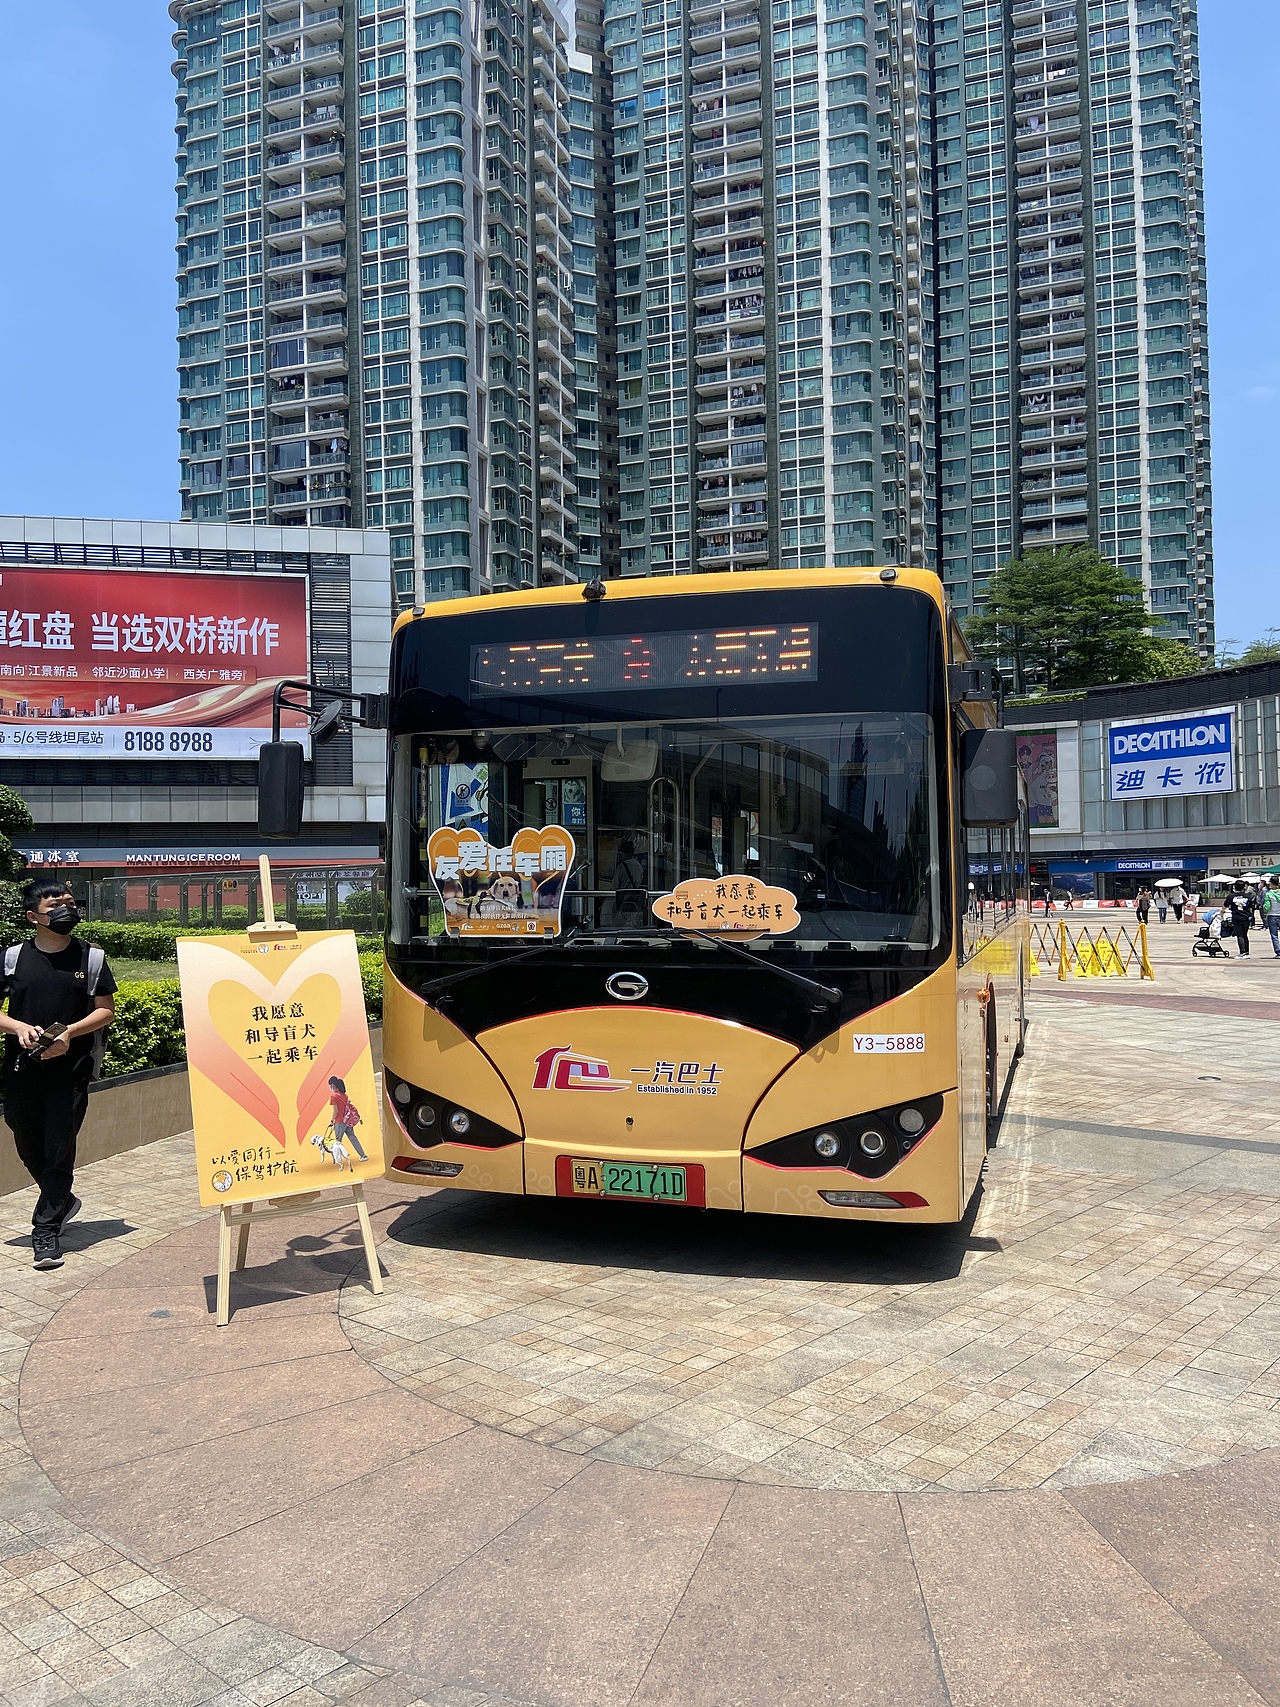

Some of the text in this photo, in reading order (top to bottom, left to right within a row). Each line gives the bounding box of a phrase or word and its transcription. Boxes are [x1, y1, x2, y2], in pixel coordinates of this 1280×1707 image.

[0, 609, 280, 656] 红盘 当选双桥新作
[91, 666, 165, 680] 邻近沙面小学
[183, 668, 243, 681] 西关广雅旁
[124, 731, 164, 751] 8188
[169, 732, 213, 752] 8988
[1113, 723, 1226, 755] DECATHLON
[1115, 761, 1226, 792] 迪卡侬
[18, 850, 80, 863] 通冰室
[126, 854, 152, 862] MAN
[153, 854, 186, 862] TUNG
[207, 853, 241, 861] ROOM
[434, 841, 567, 880] 友爱在车厢
[715, 883, 757, 900] 我愿意
[667, 901, 783, 920] 和导盲犬一起乘车
[252, 1003, 304, 1021] 我愿意
[245, 1023, 316, 1044] 和导盲犬
[854, 1036, 924, 1050] Y3-5888
[247, 1045, 318, 1065] 一起乘车
[630, 1061, 724, 1084] 一汽巴士
[637, 1084, 717, 1095] Established in 1952
[236, 1160, 299, 1181] 保驾护航
